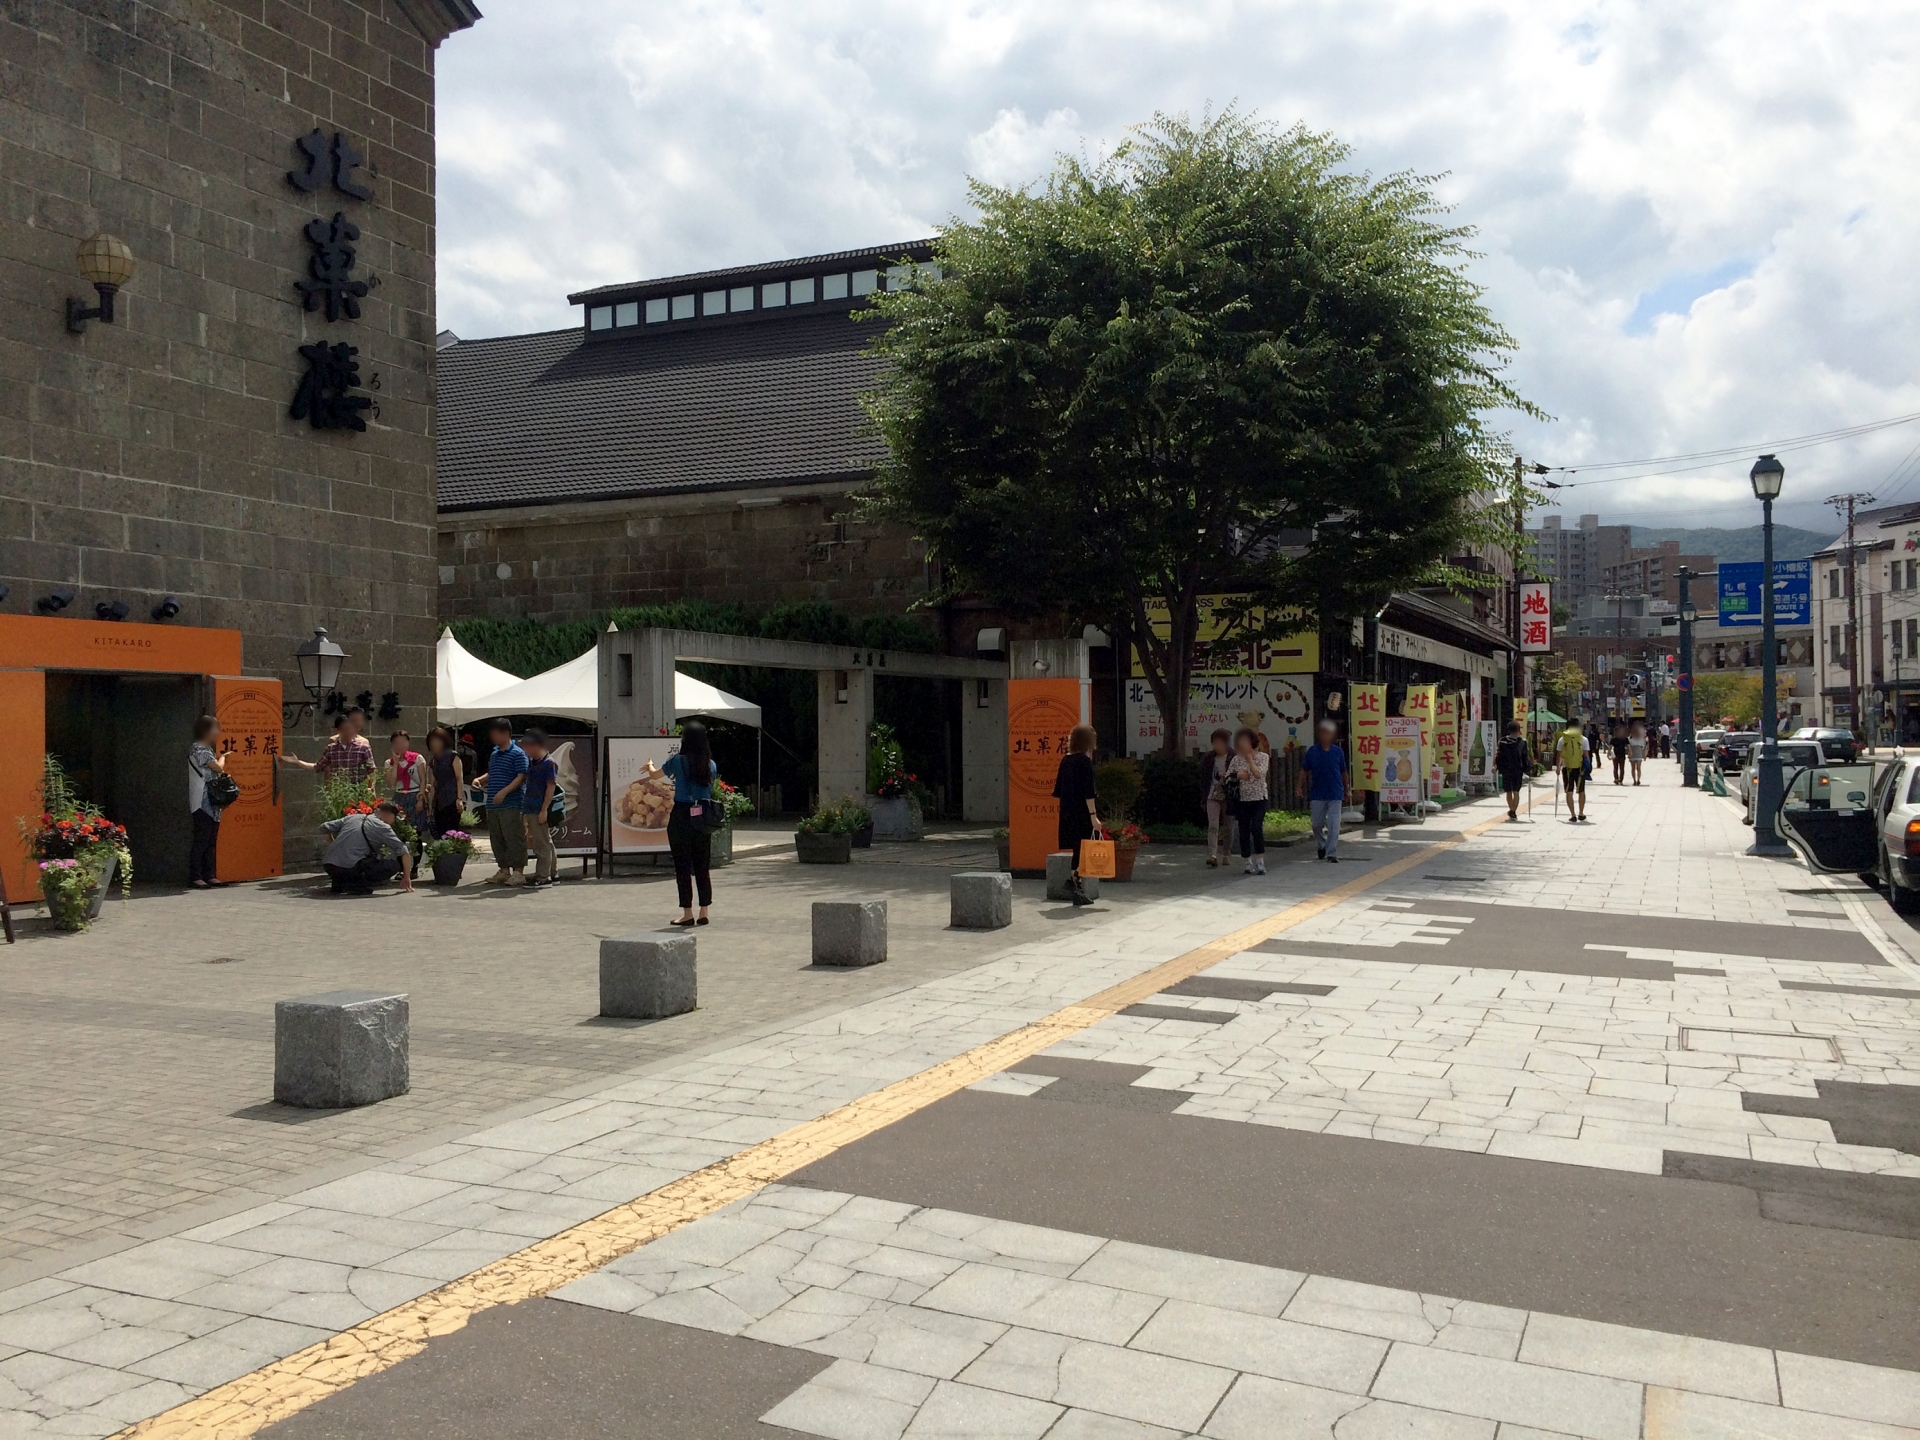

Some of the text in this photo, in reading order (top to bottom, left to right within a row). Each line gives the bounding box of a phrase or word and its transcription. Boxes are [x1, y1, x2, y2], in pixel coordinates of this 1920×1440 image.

[287, 127, 373, 432] 北菓楼
[1724, 582, 1747, 591] 札幌
[1521, 589, 1549, 646] 地酒
[94, 637, 152, 648] KITAKARO
[249, 727, 281, 735] KITAKARO
[1356, 691, 1382, 780] 北一硝子
[219, 733, 280, 756] 北菓楼
[234, 813, 266, 822] OTARU
